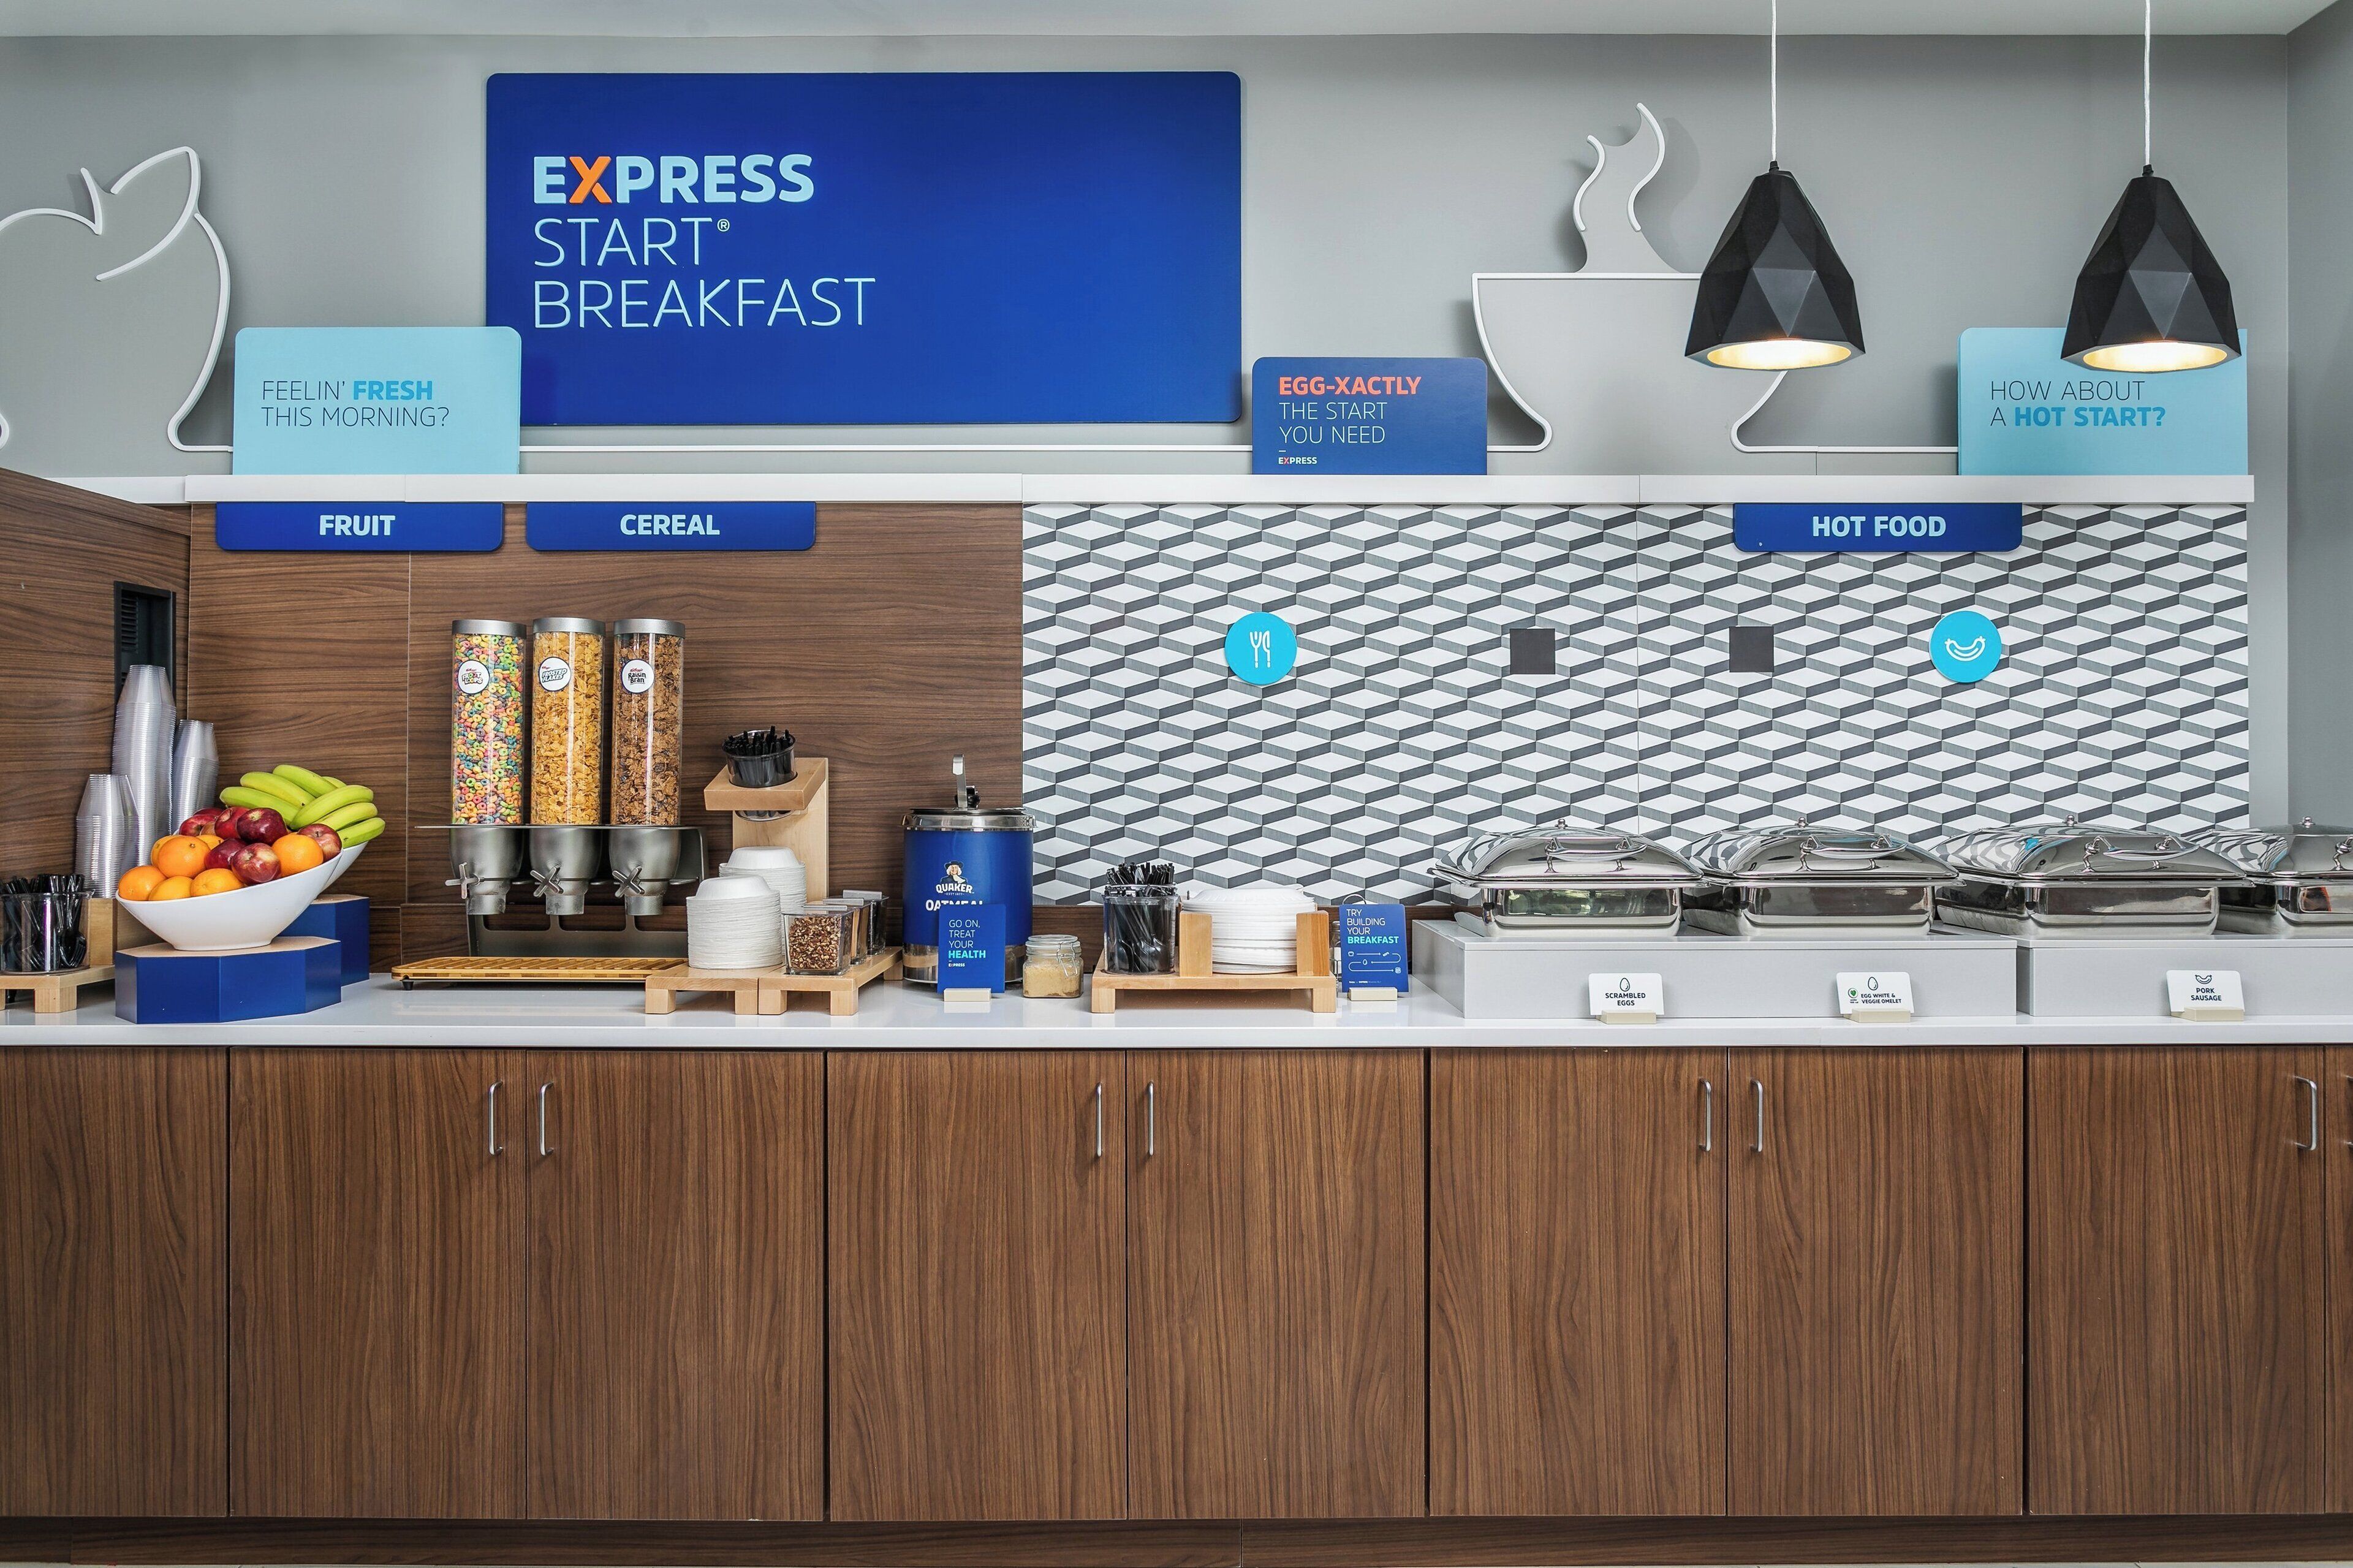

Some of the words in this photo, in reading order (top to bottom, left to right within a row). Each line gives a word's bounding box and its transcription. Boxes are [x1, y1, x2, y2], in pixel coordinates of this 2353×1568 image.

[534, 154, 814, 205] EXPRESS
[534, 278, 876, 328] BREAKFAST
[353, 380, 433, 401] FRESH
[1279, 376, 1422, 395] EGG-XACTLY
[1991, 381, 2051, 401] HOW
[2061, 381, 2145, 401] ABOUT
[261, 407, 312, 427] THIS
[322, 407, 449, 427] MORNING?
[1279, 402, 1318, 420] THE
[1326, 402, 1388, 420] START
[1990, 407, 2006, 426] A
[2015, 406, 2065, 427] HOT
[2074, 406, 2166, 427] START?
[1279, 426, 1322, 444] YOU
[1332, 426, 1385, 443] NEED
[319, 514, 396, 537] FRUIT
[620, 513, 721, 536] CEREAL
[1813, 515, 1866, 537] HOT
[1874, 515, 1946, 537] FOOD
[542, 668, 567, 678] FROSTED
[542, 674, 563, 683] FLAKES
[936, 883, 972, 894] QUAKER
[949, 919, 963, 928] GO
[964, 919, 980, 928] ON,
[1347, 926, 1371, 935] YOUR
[949, 930, 976, 938] TREAT
[1347, 936, 1399, 944] BREAKFAST
[949, 940, 974, 949] YOUR
[948, 950, 986, 959] HEALTH
